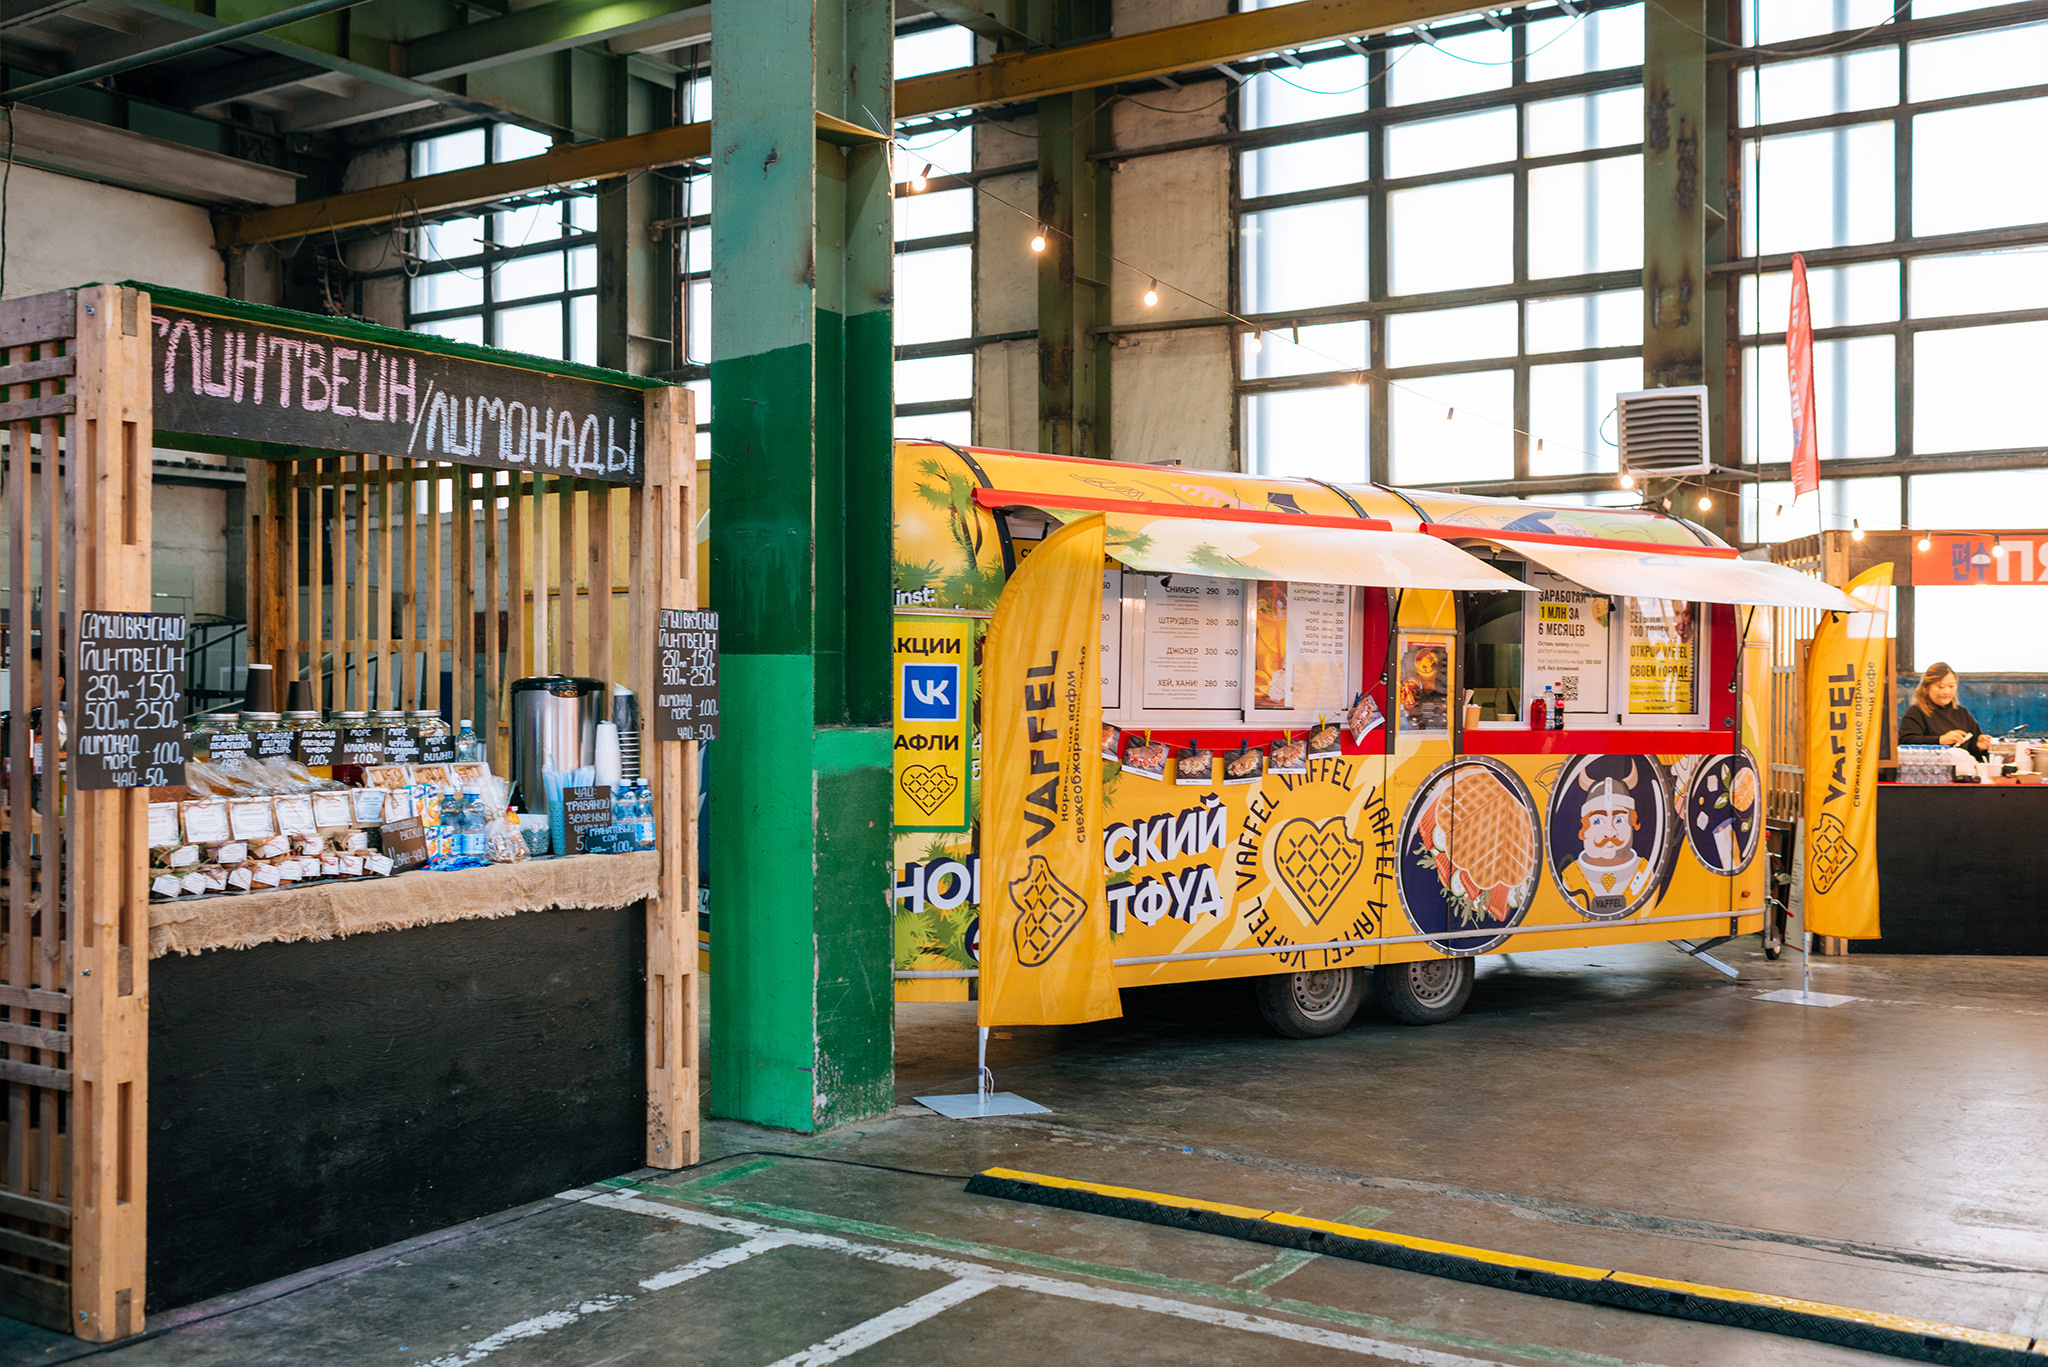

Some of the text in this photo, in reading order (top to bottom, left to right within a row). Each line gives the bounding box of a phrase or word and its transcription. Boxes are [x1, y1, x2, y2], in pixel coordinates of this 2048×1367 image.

[896, 587, 935, 606] inst:
[1158, 617, 1199, 625] ШТРУДЕЛЬ
[1541, 606, 1580, 620] 1 МЛН ЗА
[126, 615, 186, 641] ВКУСНЫЙ
[1538, 623, 1586, 638] 6 МЕСЯЦЕВ
[658, 629, 716, 650] ГЛИНТВЕЙН
[894, 638, 960, 656] КЦИИ
[80, 641, 185, 672] ГЛИНТВЕЙН
[1166, 647, 1238, 656] ДЖОКЕР 300 400
[1629, 665, 1656, 677] СВОЕМ
[1157, 678, 1174, 687] ХЕЙ,
[1175, 679, 1198, 687] ХАНИ!
[658, 694, 693, 707] ЛИМОНАД
[671, 707, 692, 720] МОРС
[79, 734, 141, 755] ЛИМОНАД
[103, 754, 137, 770] МОРС
[112, 769, 138, 788] ЧАЙ
[565, 797, 611, 812] ТРАВЯНОЙ
[1103, 794, 1227, 873] СКИЙ
[1236, 791, 1280, 891] VAFFEL
[1364, 786, 1395, 885] VAFFEL
[1595, 898, 1622, 908] VAFFEL
